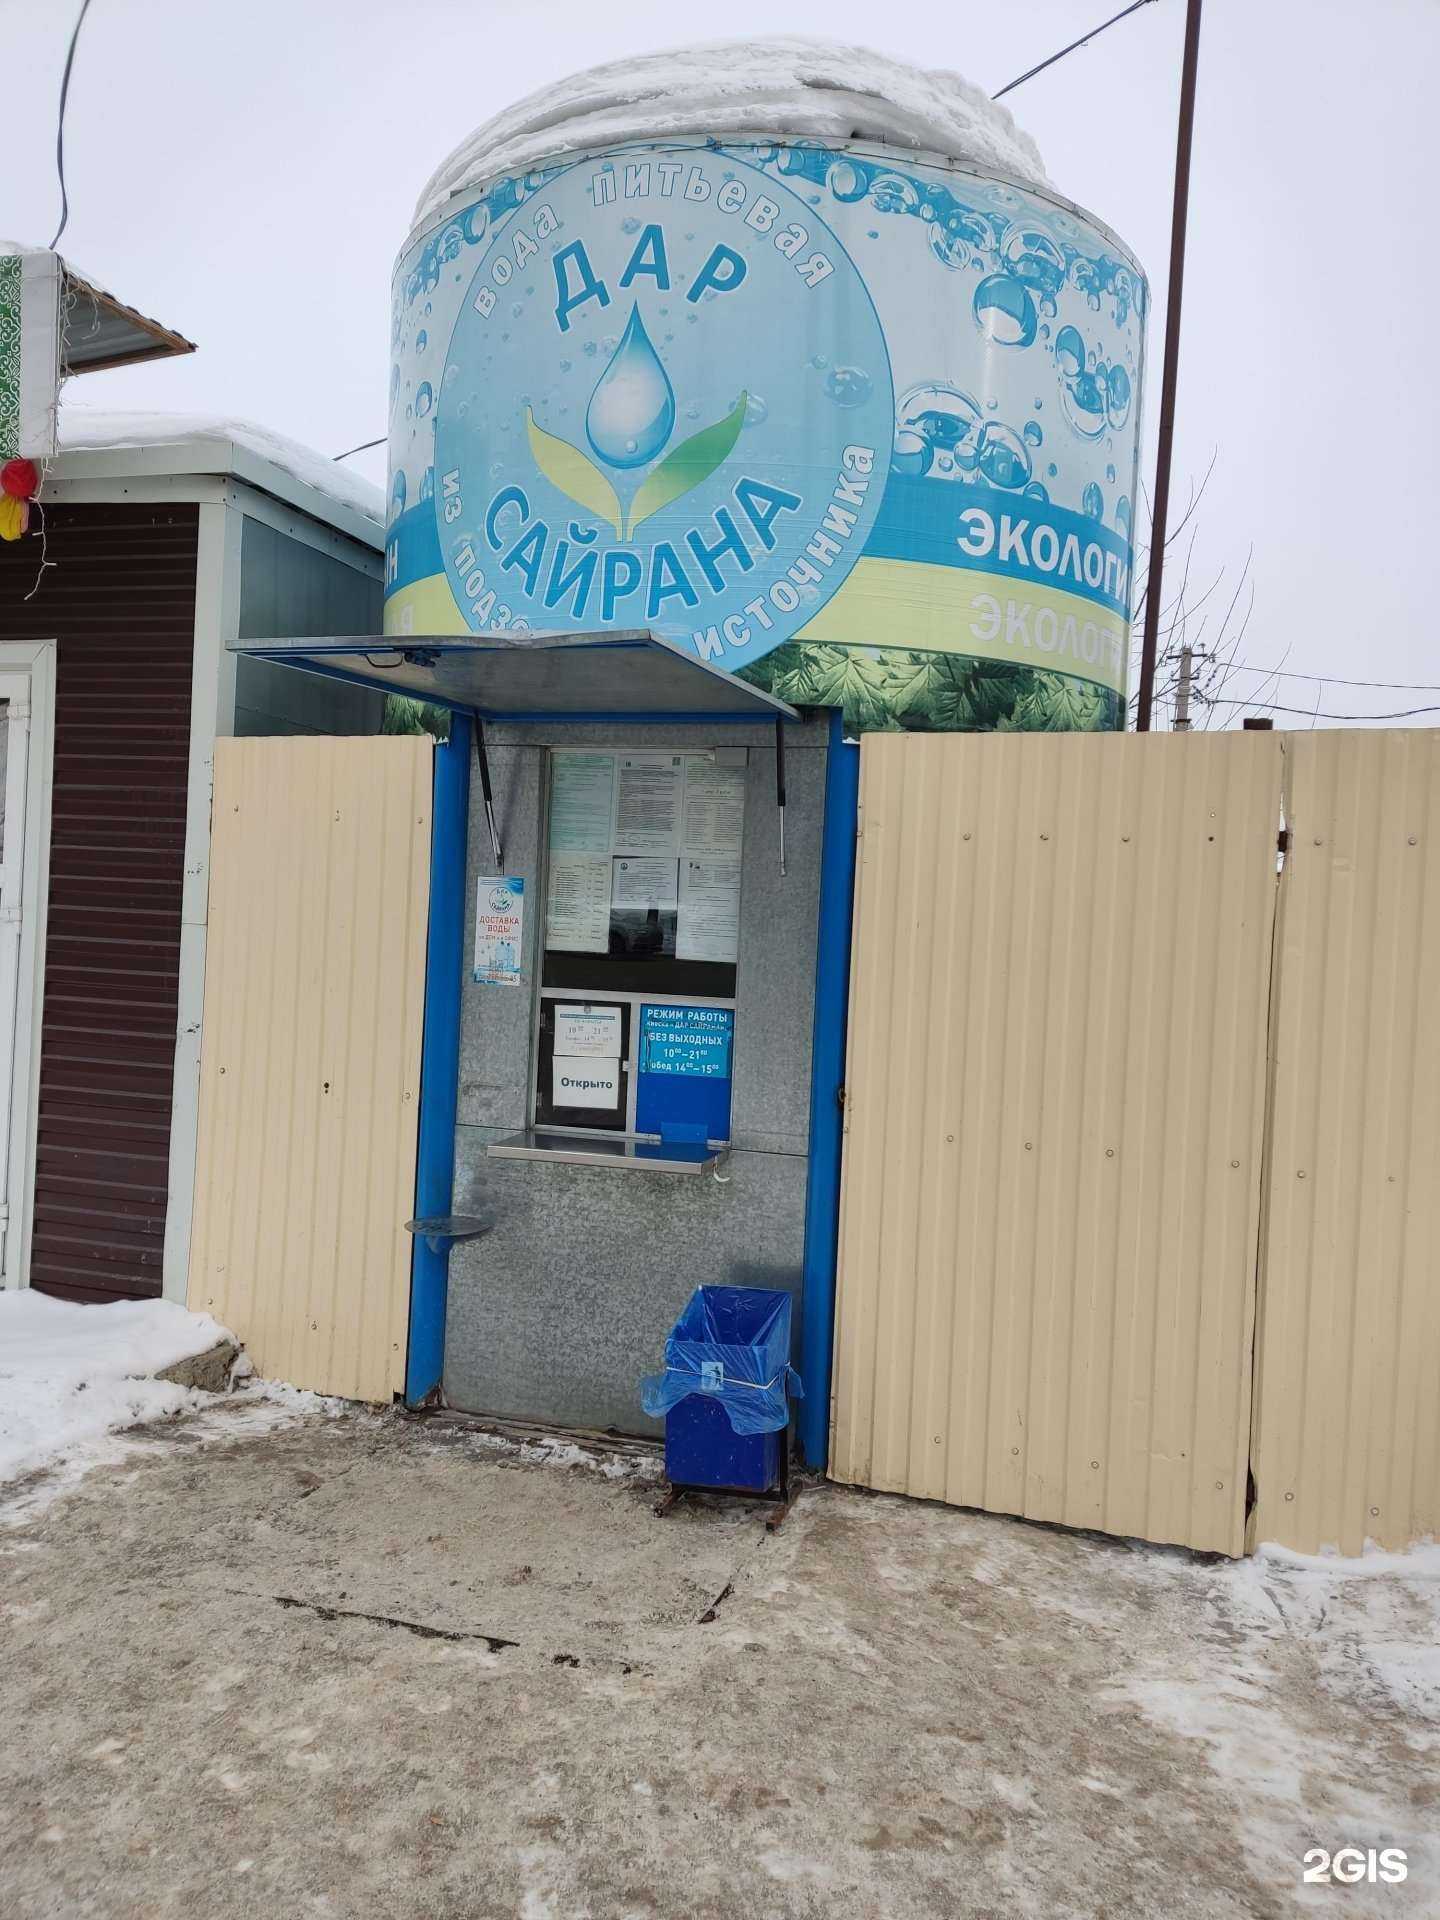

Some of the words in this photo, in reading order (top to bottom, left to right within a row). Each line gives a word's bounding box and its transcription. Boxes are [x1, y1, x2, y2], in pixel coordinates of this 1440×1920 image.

[551, 224, 747, 332] ДАР
[484, 476, 803, 622] САЙРАНА
[480, 916, 519, 924] ДОСТАВКА
[487, 925, 511, 933] ВОДЫ
[647, 1009, 683, 1020] РЕЖИМ
[687, 1011, 727, 1022] РАБОТЫ
[649, 1032, 667, 1042] БЕЗ
[668, 1033, 722, 1046] ВЫХОДНЫХ
[561, 1077, 613, 1090] Открыто
